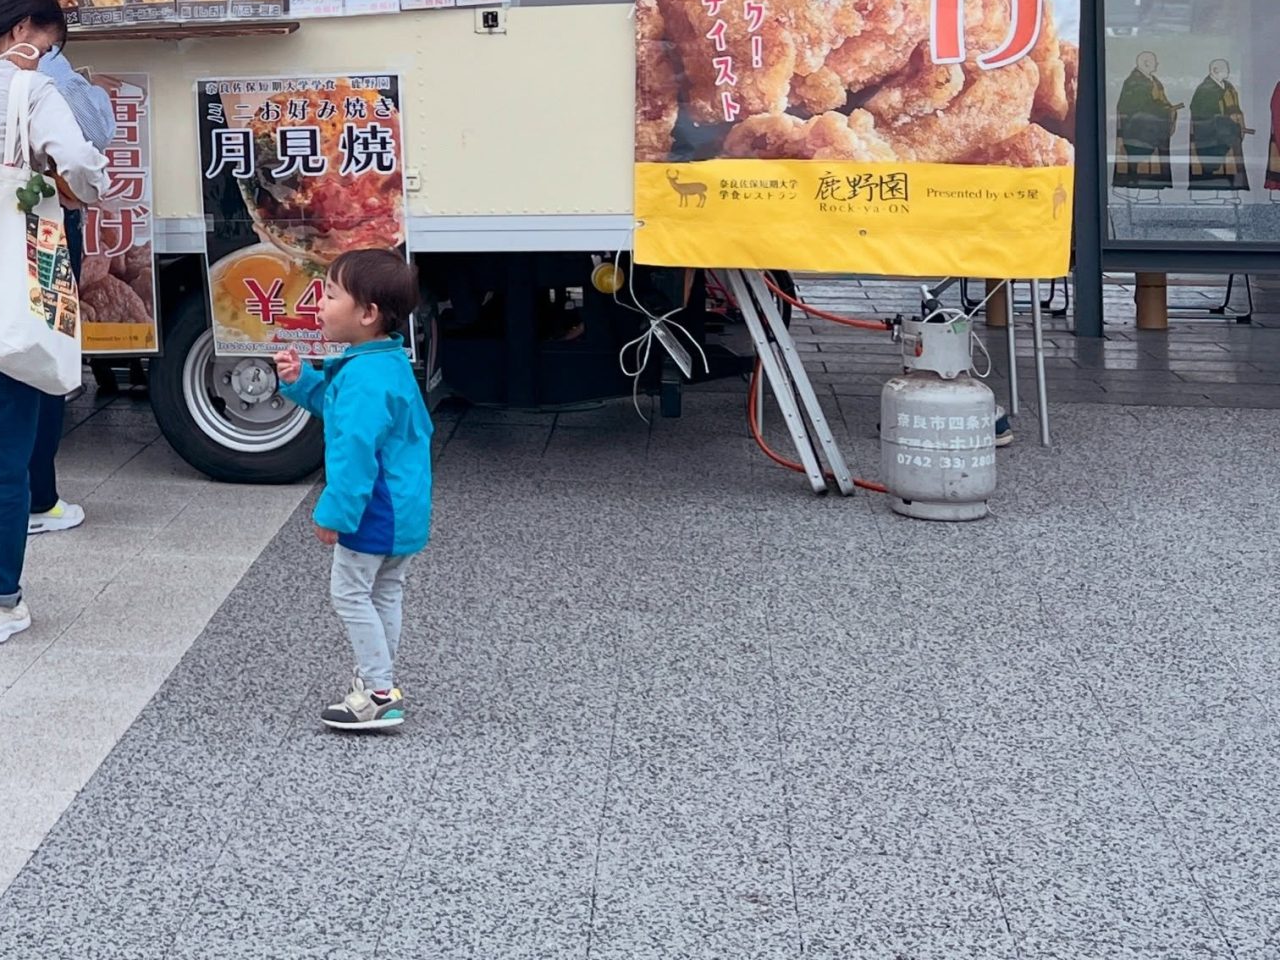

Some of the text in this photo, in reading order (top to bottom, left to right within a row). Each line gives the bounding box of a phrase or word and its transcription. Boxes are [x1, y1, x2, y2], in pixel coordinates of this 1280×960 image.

[351, 76, 391, 90] 鹿野園
[207, 97, 394, 123] ミニお好み焼き
[205, 122, 396, 178] 月見焼
[720, 178, 799, 190] 奈良佐保短期大学
[814, 170, 909, 203] 鹿野園
[926, 187, 1039, 202] Presented by いち屋
[243, 278, 325, 325] ¥4
[897, 412, 995, 430] 奈良市四条大
[896, 453, 932, 468] 0742
